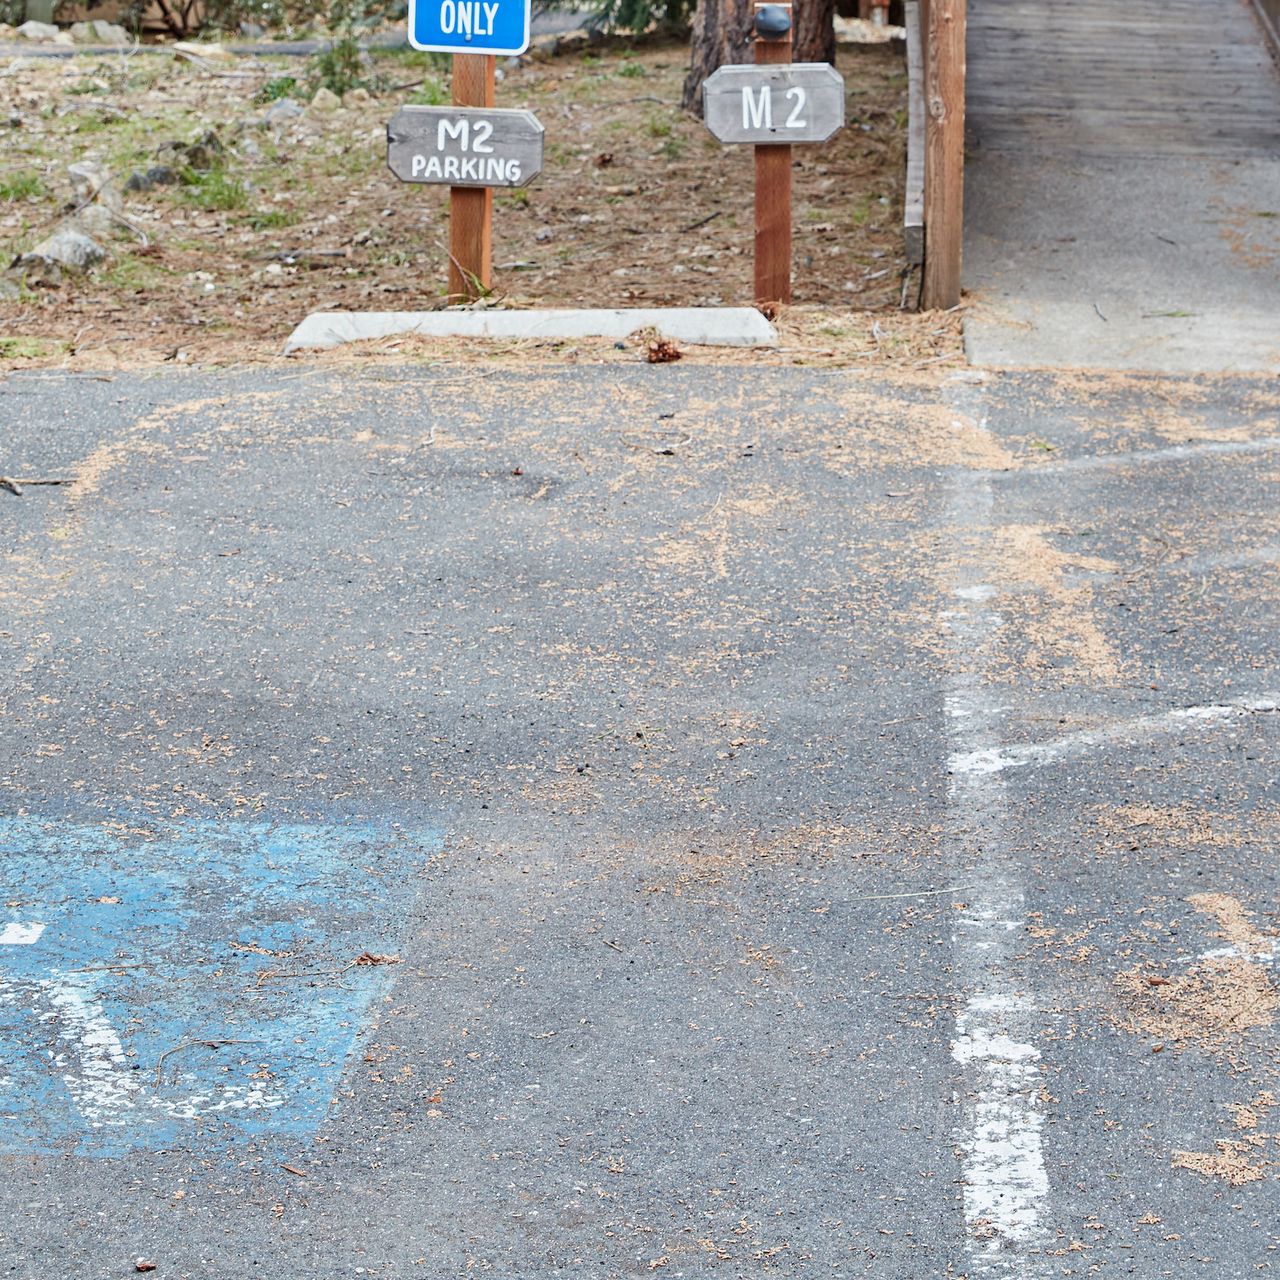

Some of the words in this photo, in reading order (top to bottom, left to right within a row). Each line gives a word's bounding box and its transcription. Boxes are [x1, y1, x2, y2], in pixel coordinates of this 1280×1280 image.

[440, 0, 499, 36] ONLY
[437, 118, 494, 153] M2
[411, 154, 522, 182] PARKING
